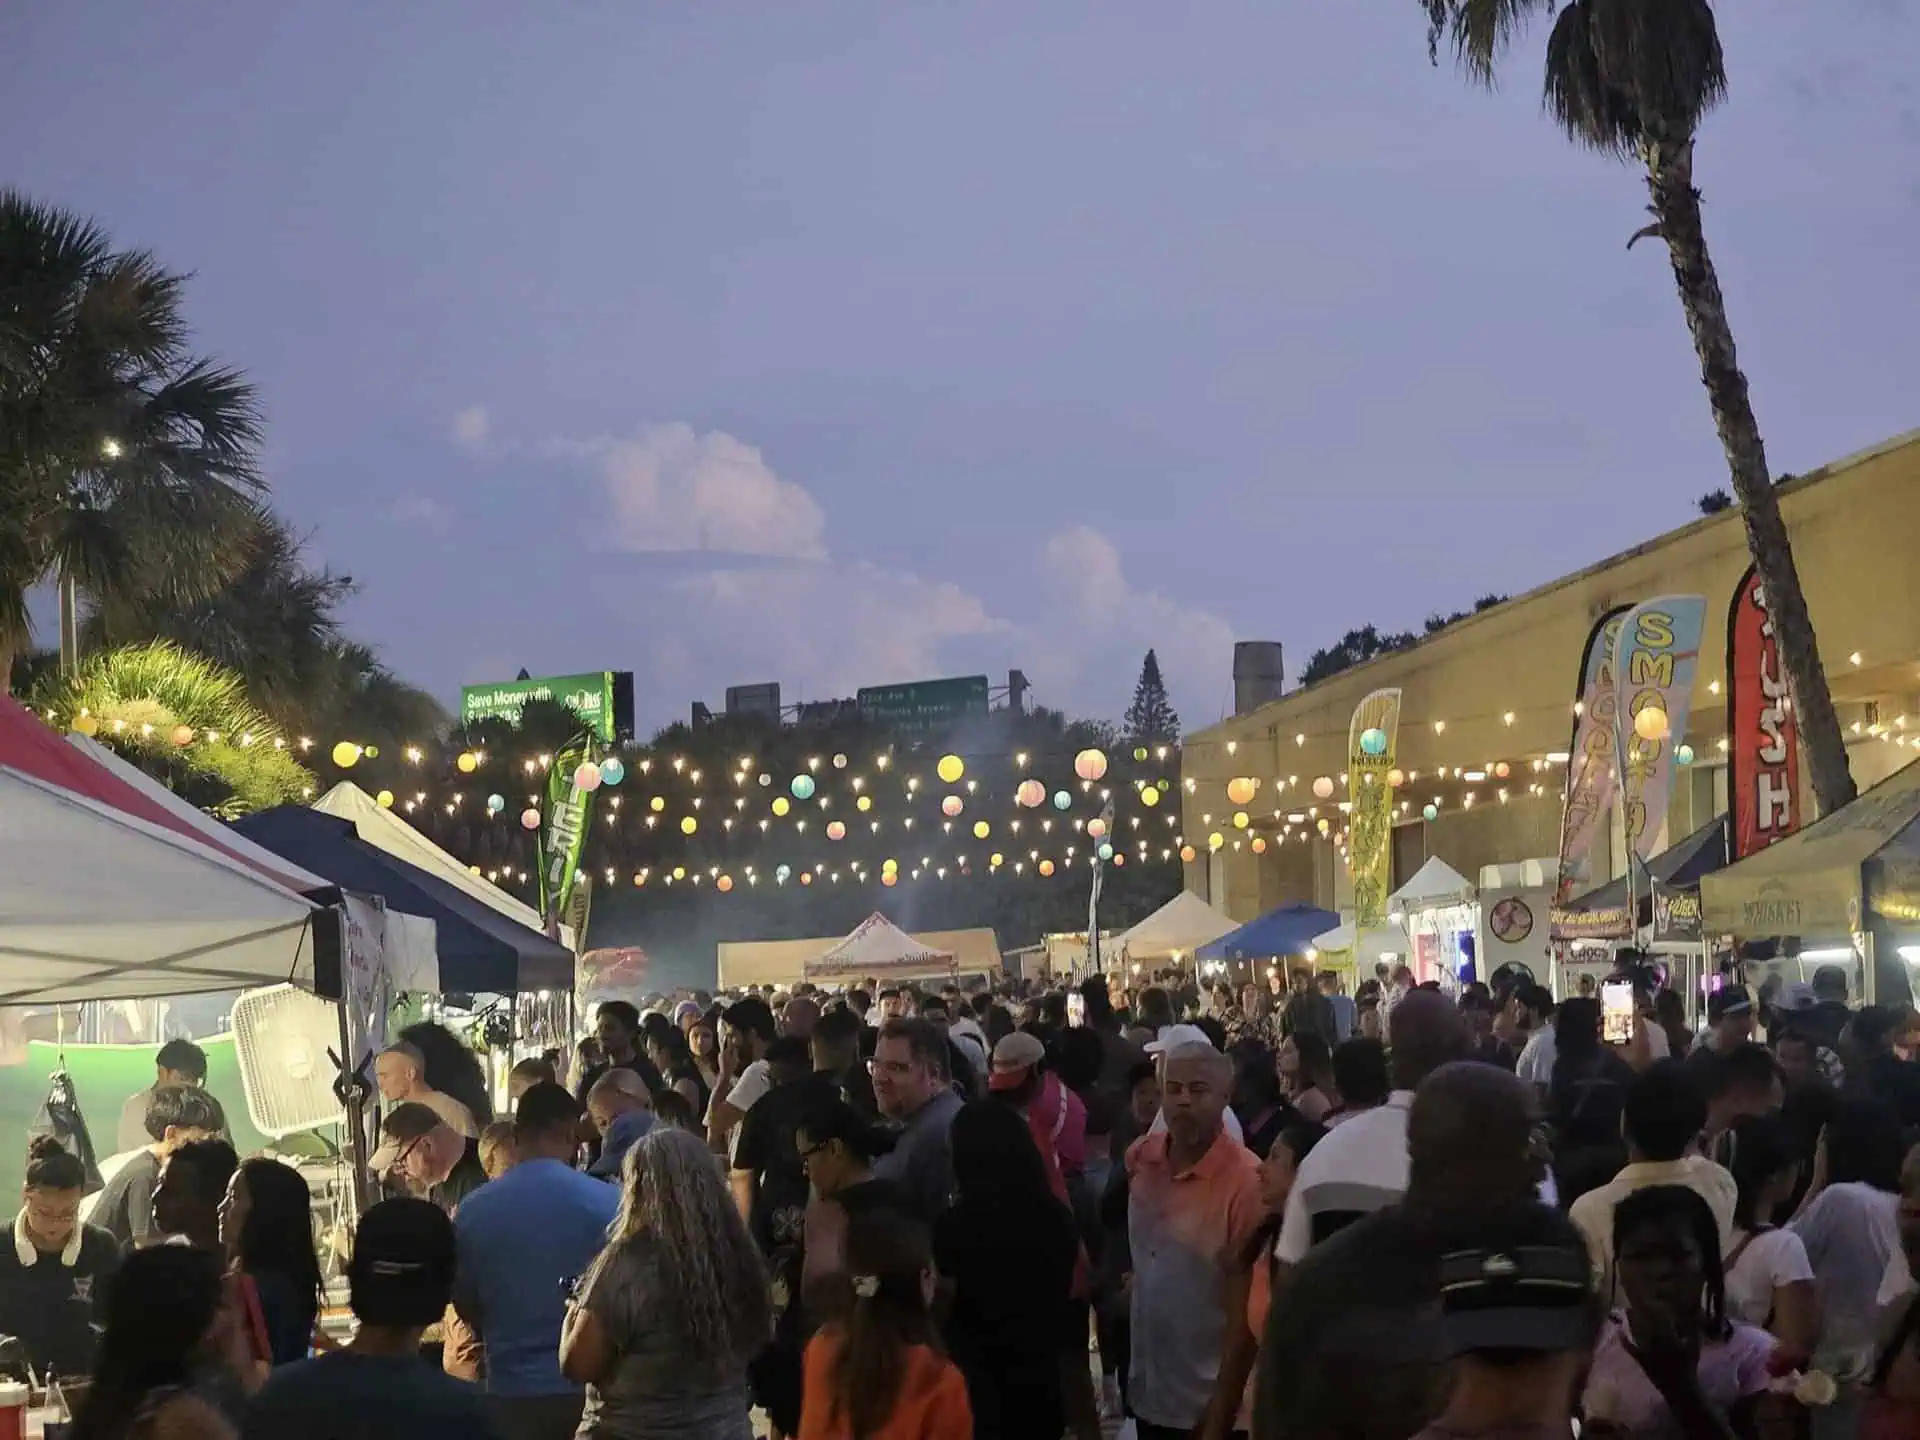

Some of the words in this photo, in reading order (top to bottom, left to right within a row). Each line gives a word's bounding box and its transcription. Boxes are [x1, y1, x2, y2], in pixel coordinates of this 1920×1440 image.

[467, 693, 491, 709] Save
[494, 690, 527, 707] Money
[529, 685, 552, 701] with
[1754, 586, 1790, 844] USH
